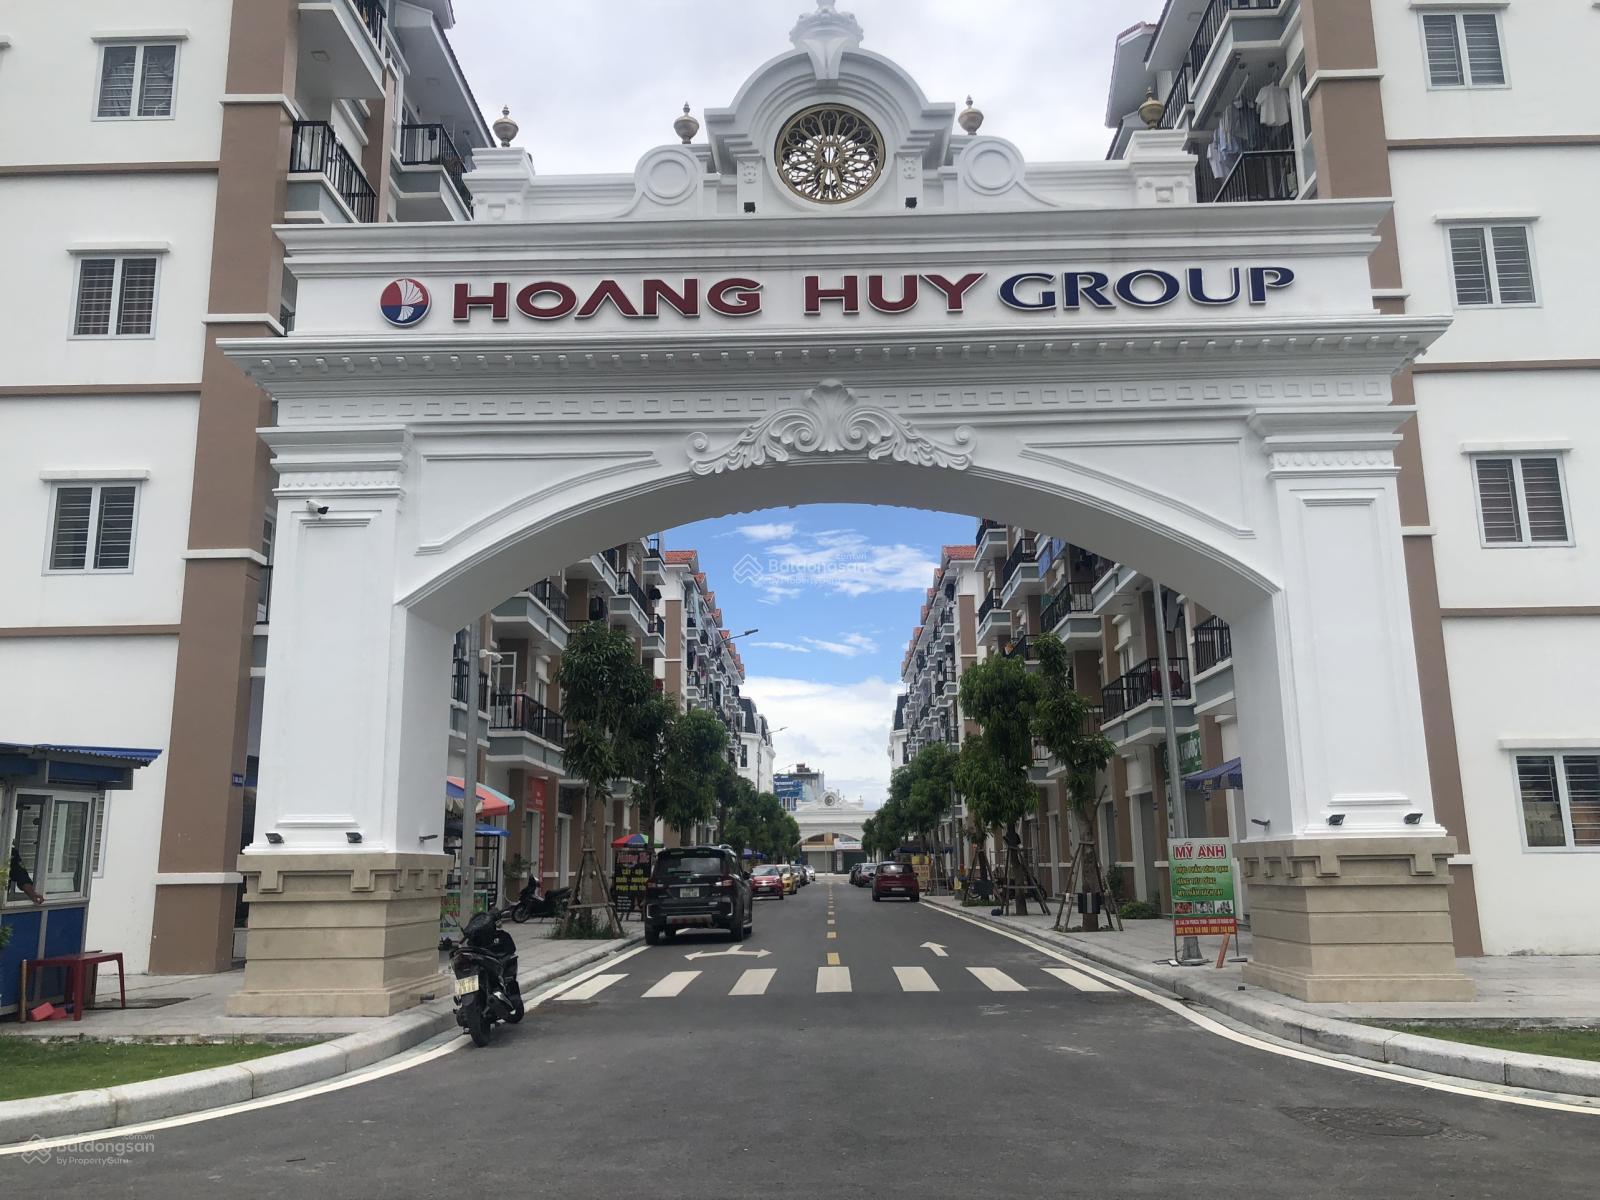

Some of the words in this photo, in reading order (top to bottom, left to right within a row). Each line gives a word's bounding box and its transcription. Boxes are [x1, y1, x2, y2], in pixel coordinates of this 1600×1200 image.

[452, 276, 764, 322] HOANG
[802, 271, 988, 315] HUY
[997, 266, 1296, 312] GROUP
[1174, 842, 1193, 859] MỸ
[1198, 844, 1226, 859] ANH
